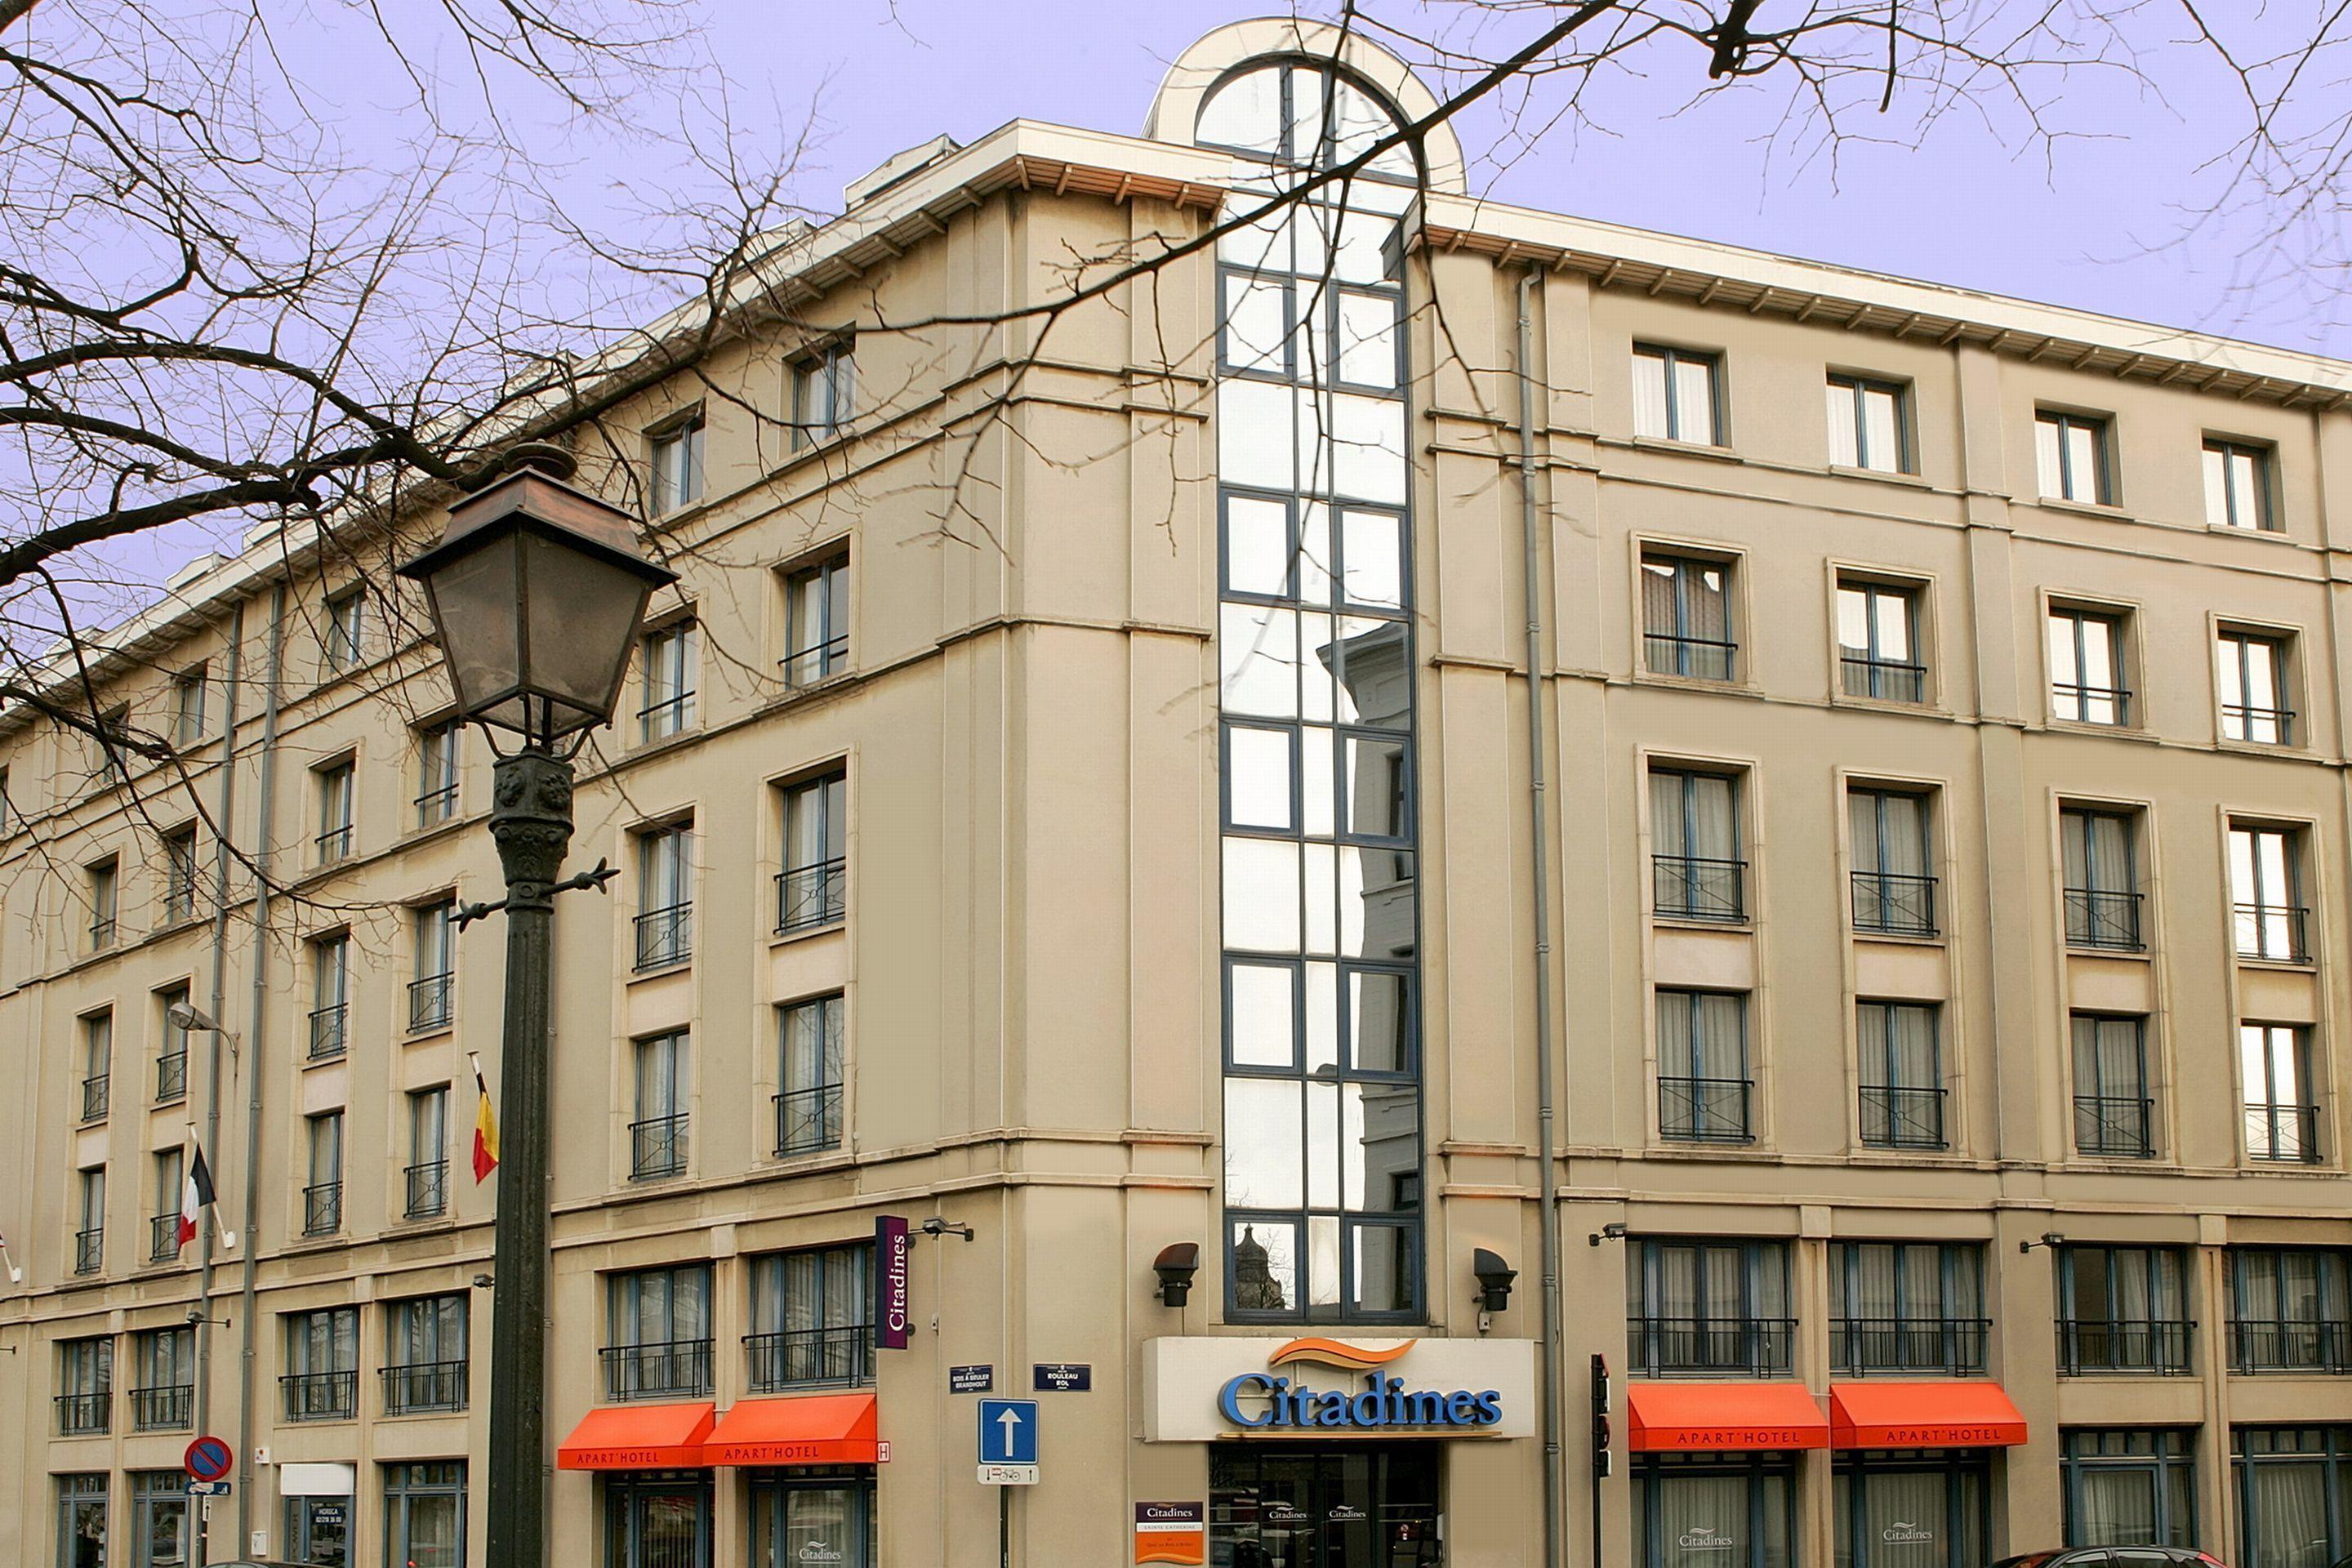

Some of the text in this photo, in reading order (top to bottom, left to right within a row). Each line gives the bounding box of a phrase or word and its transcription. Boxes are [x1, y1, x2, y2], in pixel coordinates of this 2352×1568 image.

[889, 1235, 905, 1332] Citadines
[1218, 1370, 1503, 1428] Citadines
[1677, 1432, 1800, 1444] APART'HOTEL
[1886, 1430, 2001, 1441] APART'HOTEL
[577, 1452, 659, 1463] APART'HOTEL
[724, 1446, 819, 1459] APART'HOTEL
[880, 1445, 888, 1459] H
[1147, 1508, 1193, 1517] Citadines
[1269, 1511, 1307, 1519] Citadines
[1329, 1510, 1366, 1518] Citadines
[1883, 1528, 1933, 1541] Citadines
[1679, 1535, 1733, 1547] Citadines
[799, 1548, 841, 1560] Citadines
